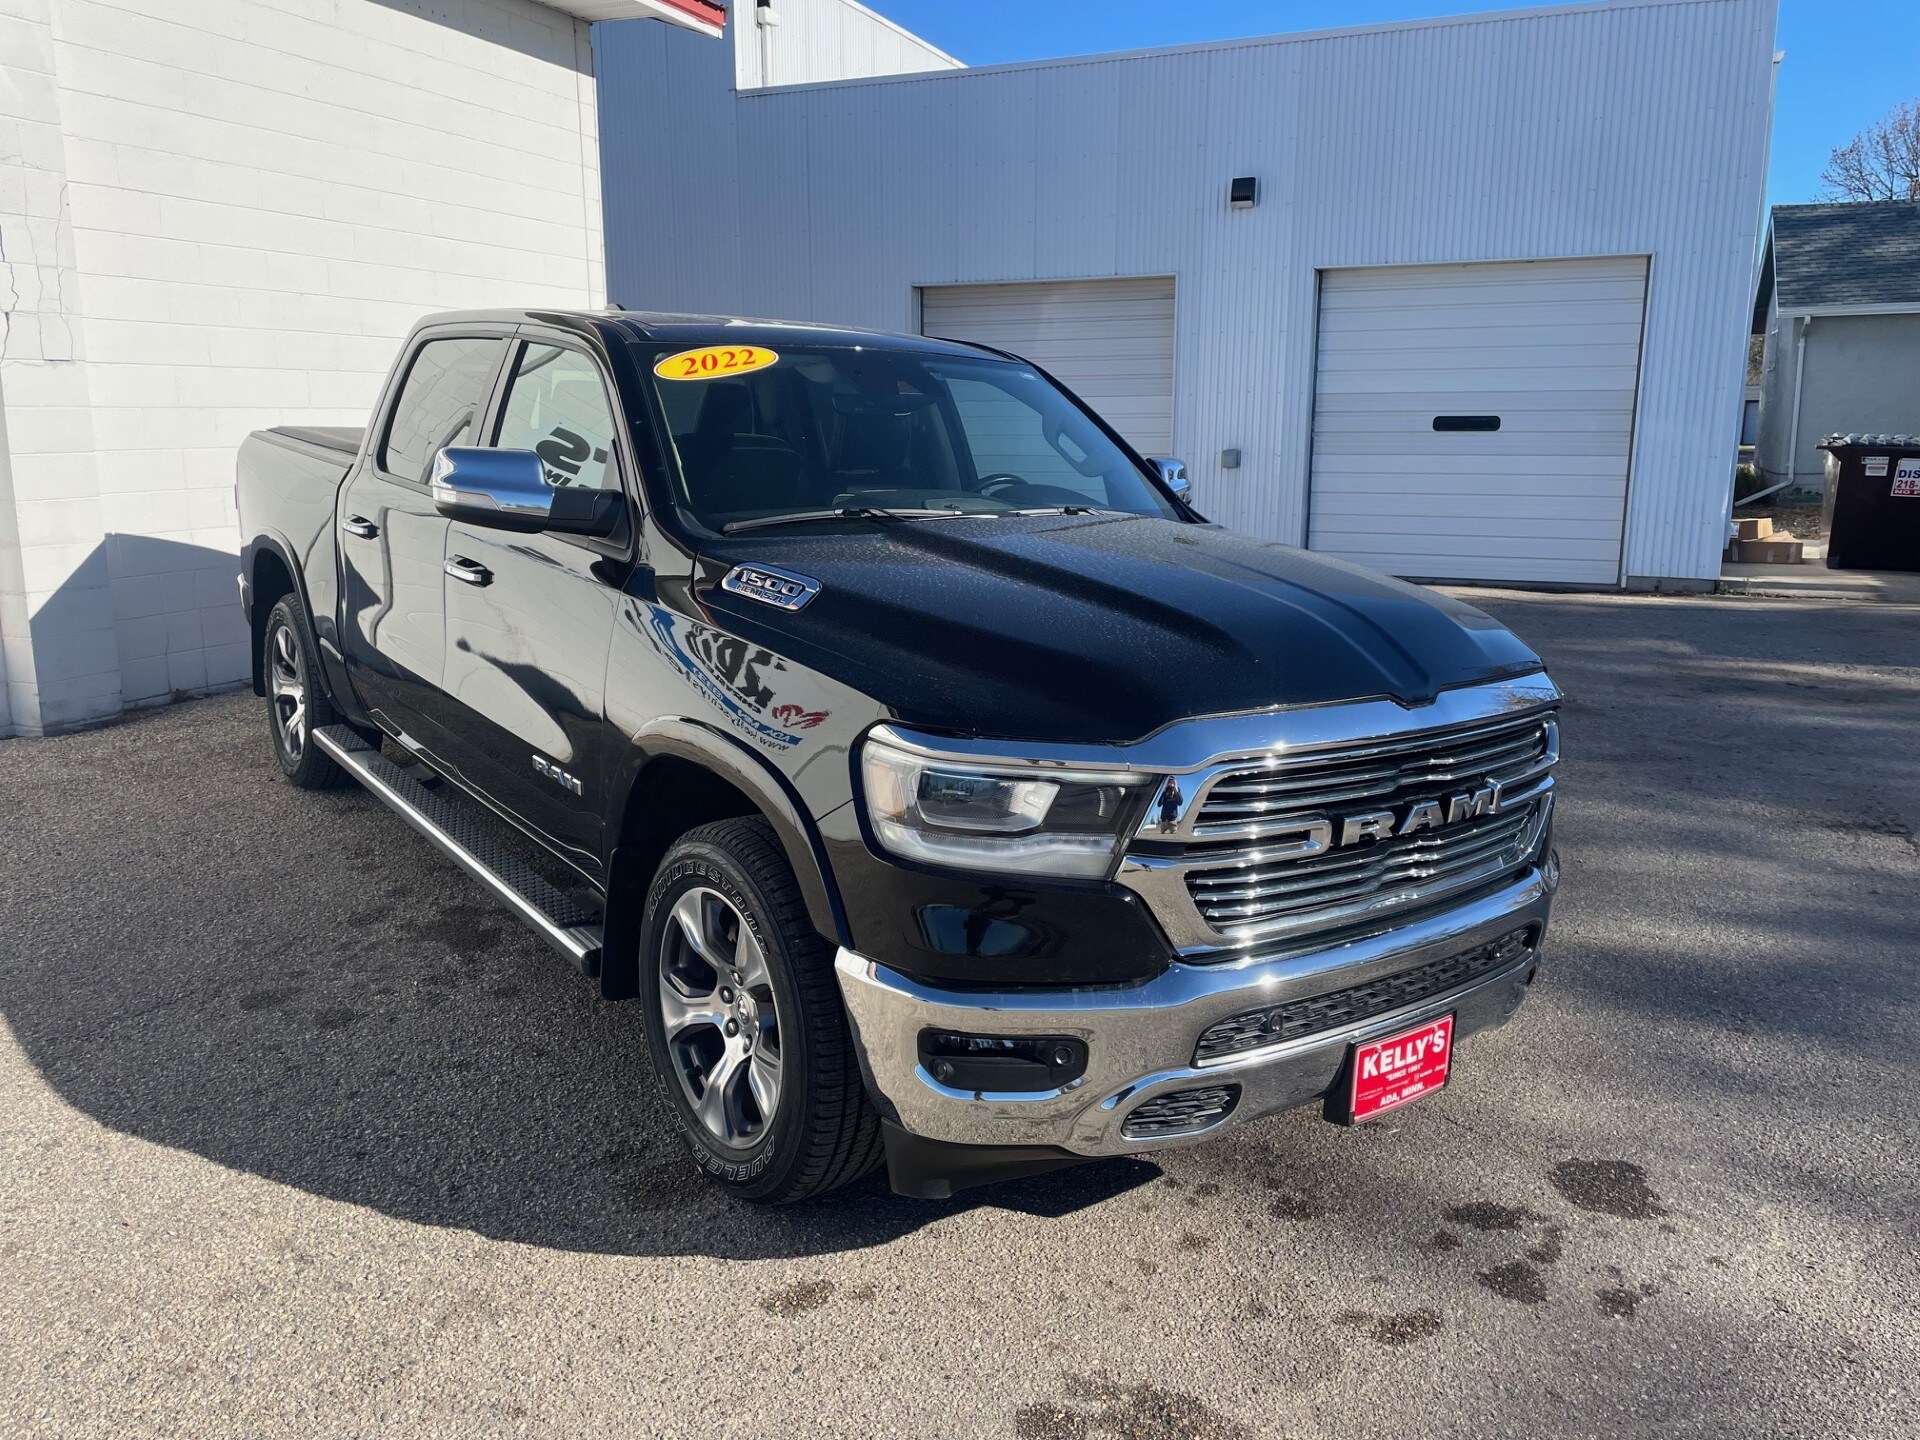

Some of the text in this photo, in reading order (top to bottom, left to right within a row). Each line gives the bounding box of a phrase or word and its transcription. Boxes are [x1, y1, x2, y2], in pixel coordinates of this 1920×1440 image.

[681, 349, 756, 376] 2022
[1896, 480, 1920, 489] 218-
[740, 568, 802, 598] 1500
[1340, 786, 1493, 848] RAM
[648, 860, 769, 956] BRIDGESTONE
[1362, 1029, 1446, 1080] KELLY'S
[1380, 1091, 1400, 1107] ADA,
[1401, 1081, 1425, 1099] MINN.
[690, 1134, 776, 1181] DUELER
